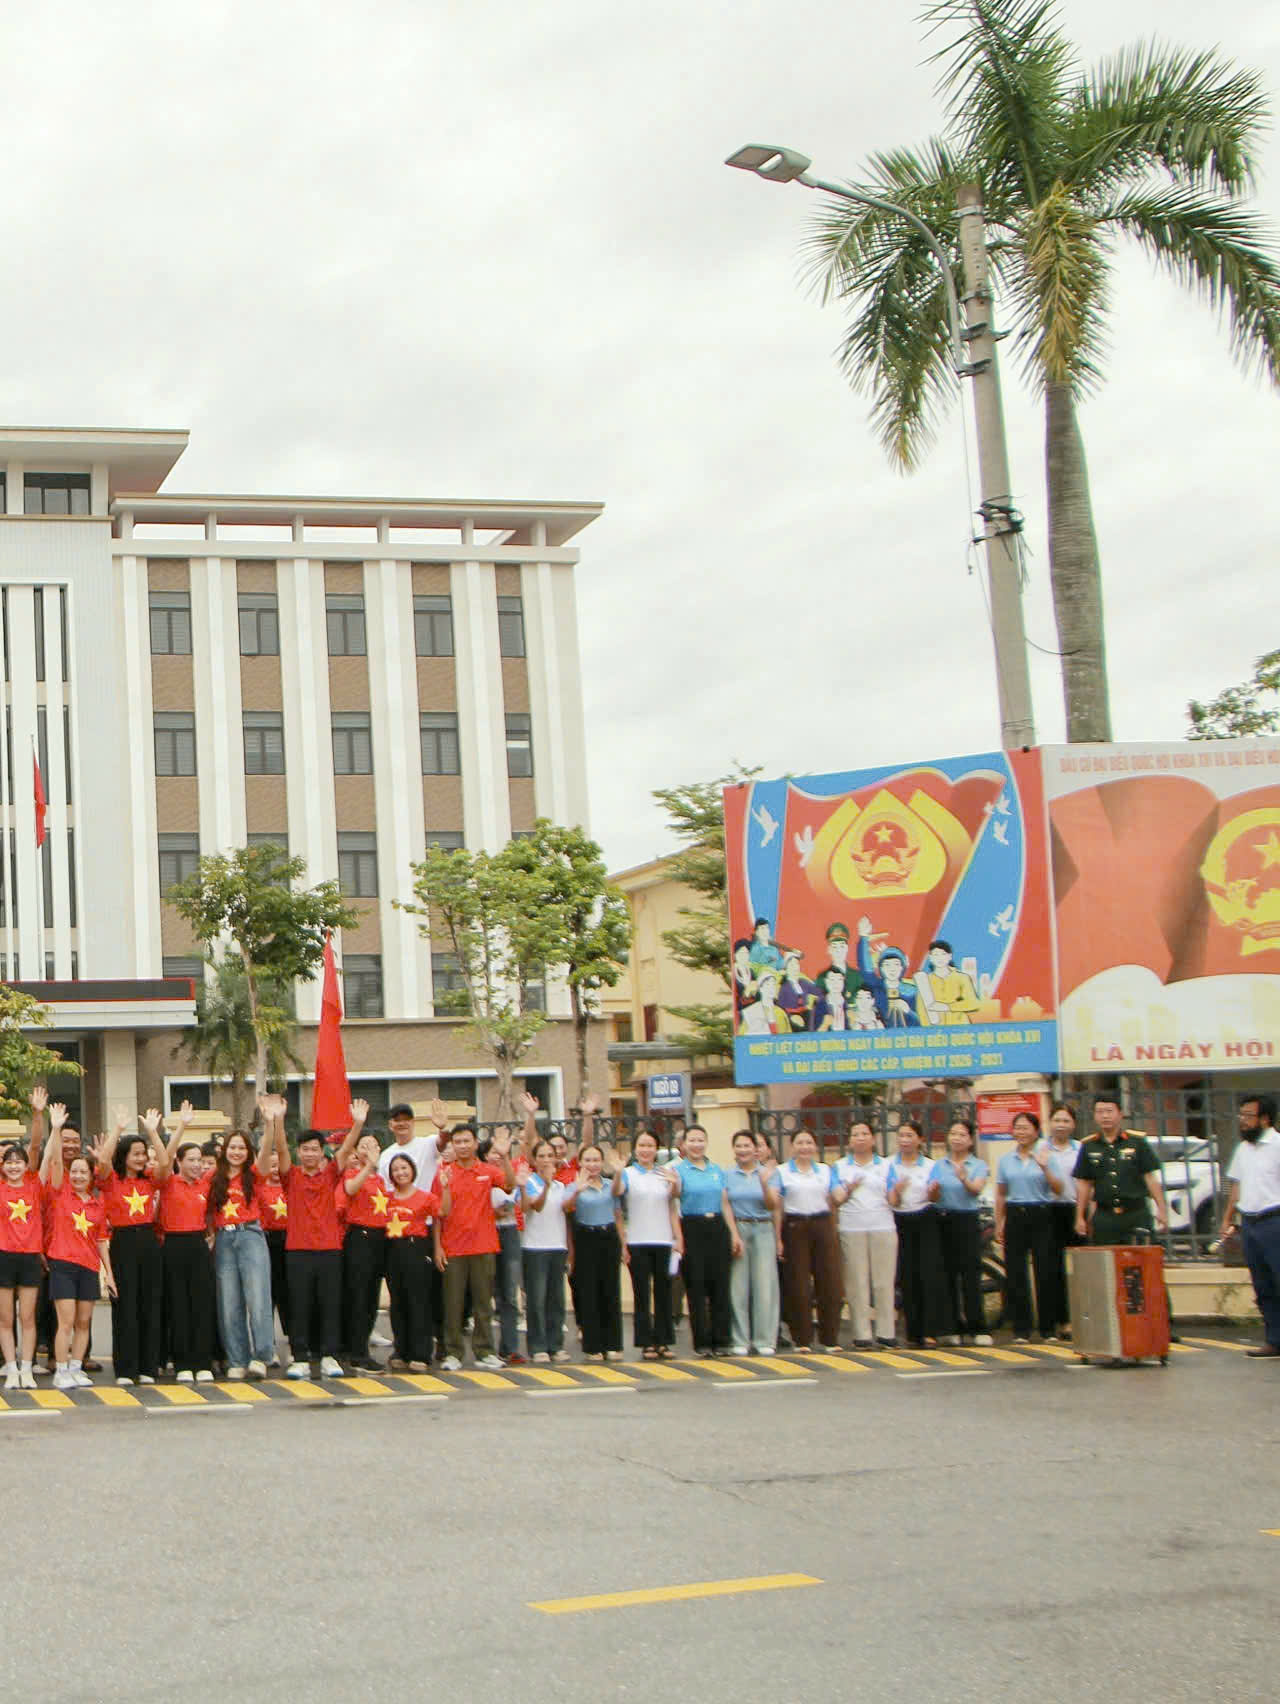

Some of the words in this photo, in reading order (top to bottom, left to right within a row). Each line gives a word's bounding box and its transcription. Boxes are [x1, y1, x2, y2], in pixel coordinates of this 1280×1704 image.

[1091, 1042, 1125, 1061] LÀ
[1135, 1040, 1212, 1060] NGÀY
[1224, 1038, 1275, 1060] HỘI
